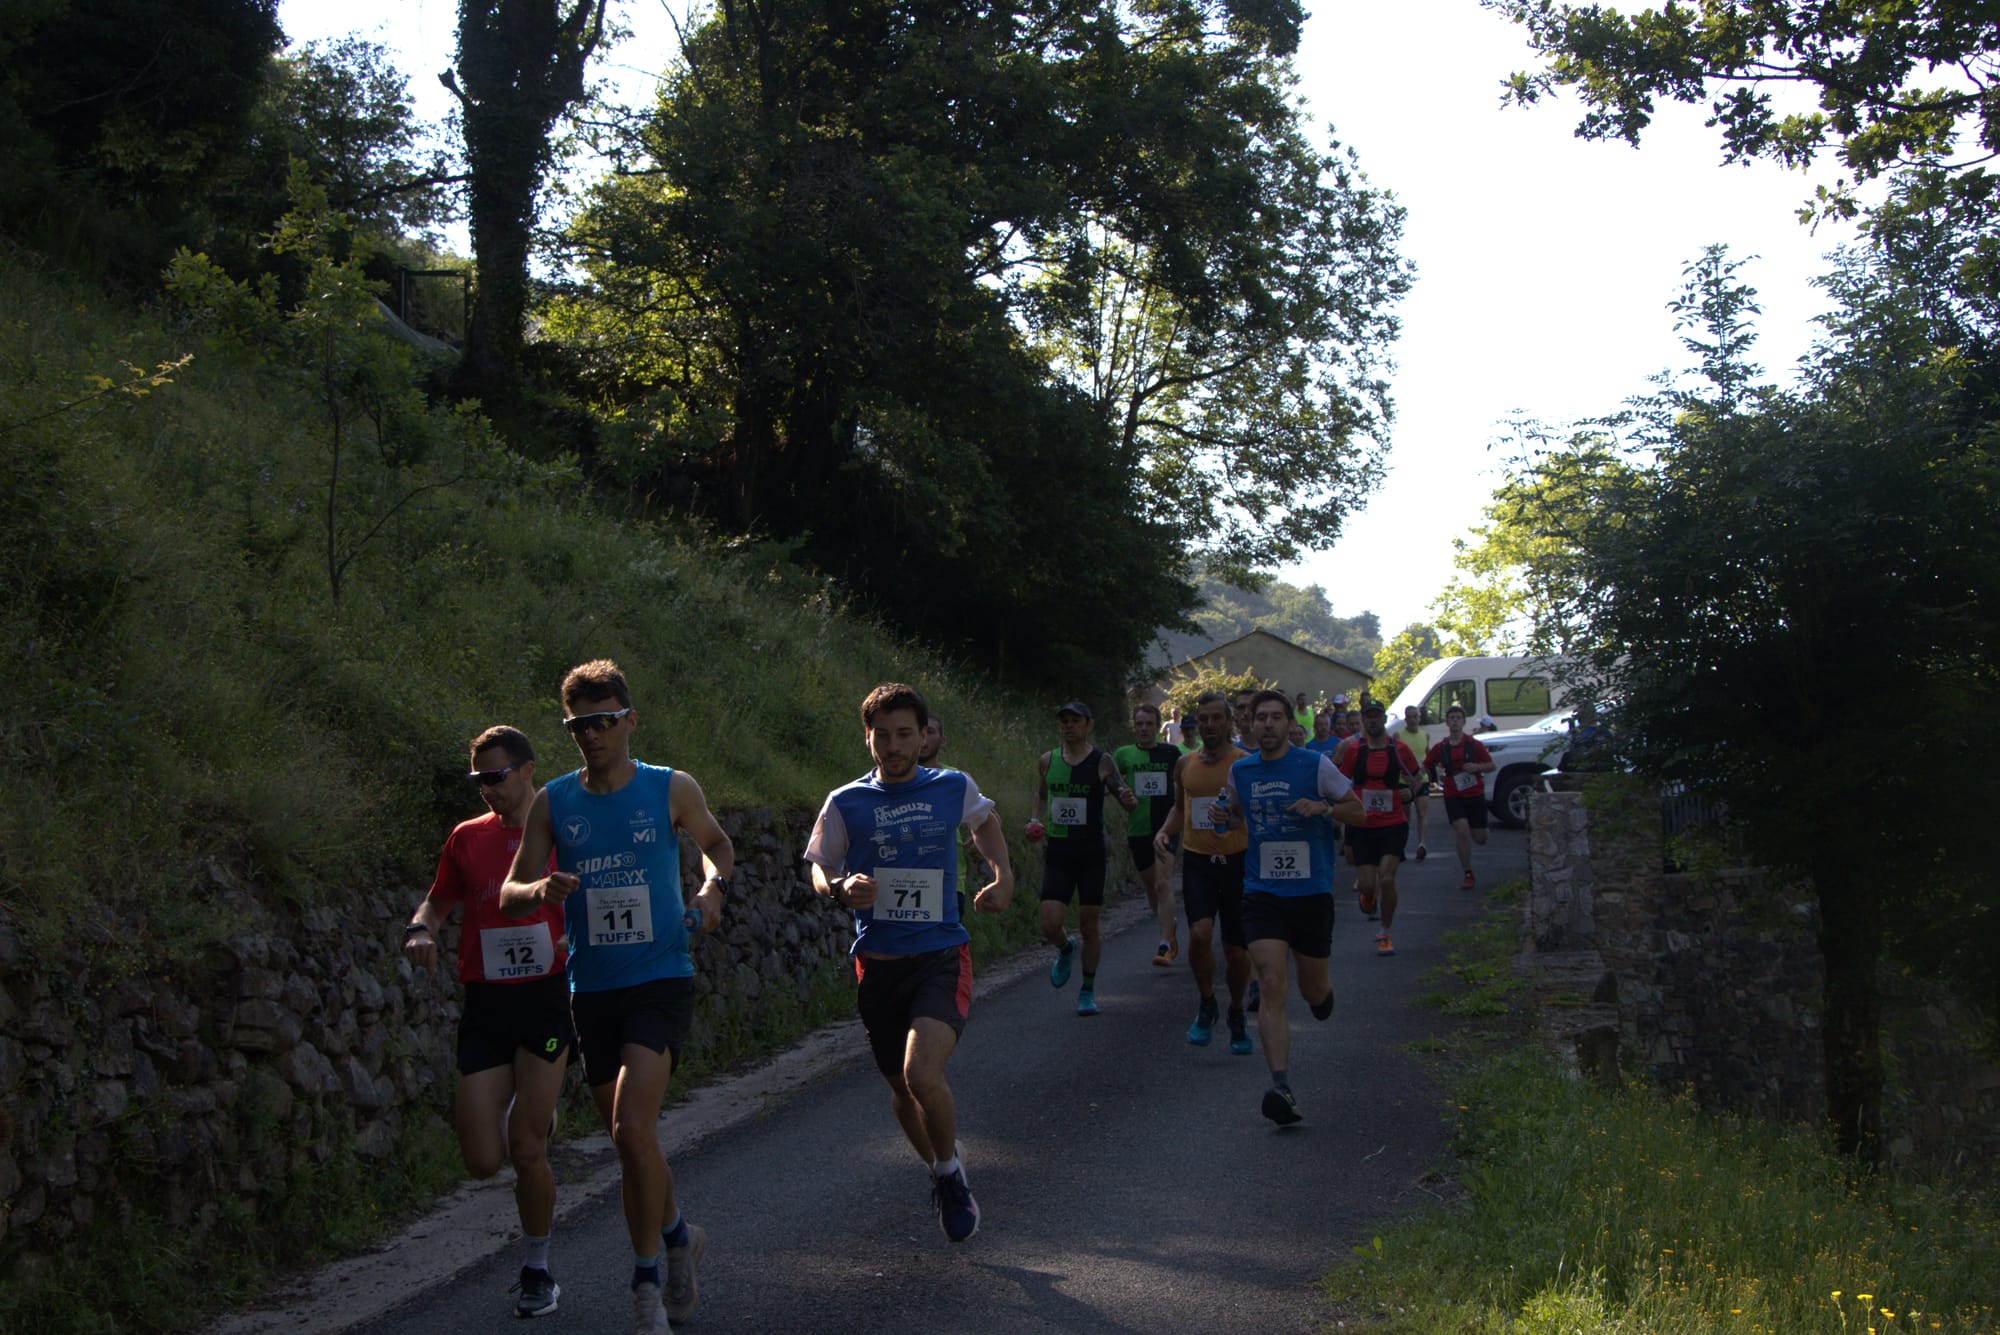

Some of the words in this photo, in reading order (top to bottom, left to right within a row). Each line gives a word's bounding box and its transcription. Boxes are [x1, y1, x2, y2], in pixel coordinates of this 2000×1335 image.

[1144, 781, 1159, 790] 45
[1371, 798, 1385, 807] 83
[1060, 808, 1076, 818] 20
[576, 853, 622, 877] SIDAS
[1274, 856, 1296, 870] 32
[591, 868, 647, 889] MATRYX
[894, 889, 921, 908] 71
[603, 909, 633, 930] 11
[887, 909, 930, 920] TUFF'S
[597, 930, 646, 943] TUFF'S
[504, 946, 535, 965] 12
[498, 964, 544, 977] TUFF'S
